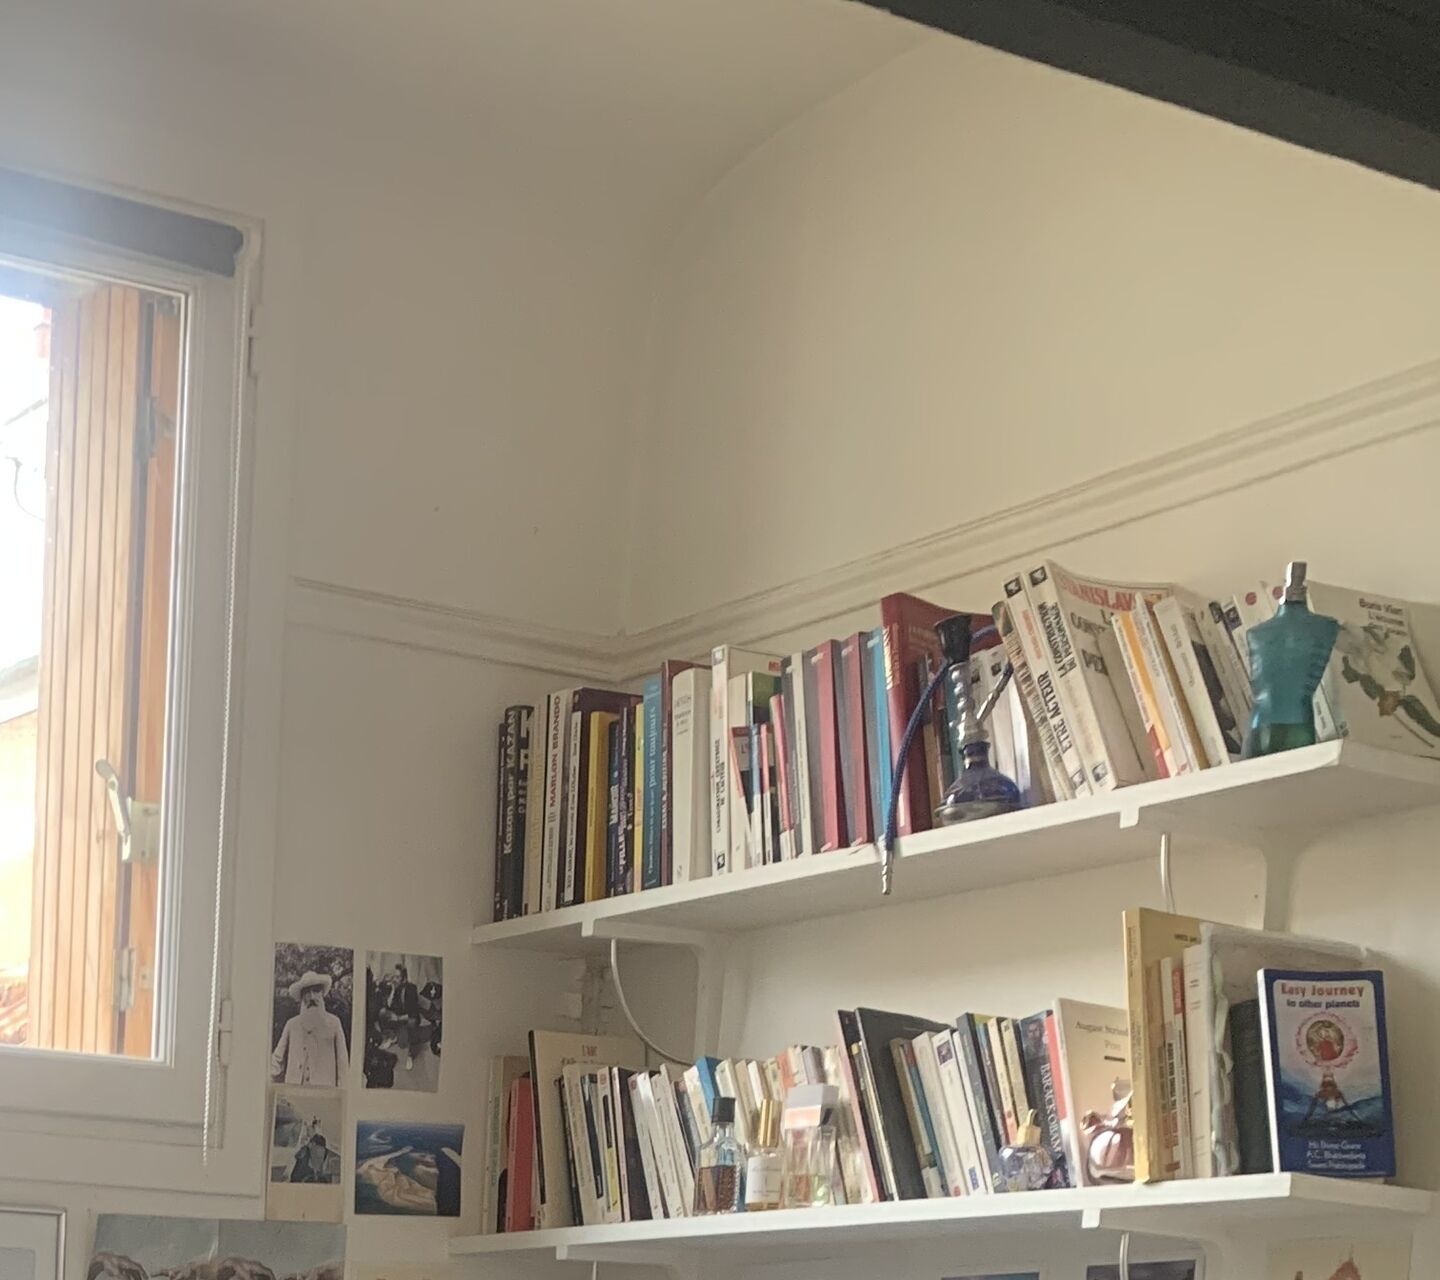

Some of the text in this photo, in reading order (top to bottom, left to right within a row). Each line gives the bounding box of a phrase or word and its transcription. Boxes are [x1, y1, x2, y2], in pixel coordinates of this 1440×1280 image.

[1038, 670, 1061, 719] ACTEUR
[549, 695, 561, 808] MARLON BRANDO
[648, 706, 658, 757] toujours
[503, 709, 517, 854] Kazan par KAZAN
[1280, 983, 1365, 998] Easy Journey
[1325, 999, 1360, 1010] planets
[1040, 1063, 1063, 1160] BARACK OBAMA
